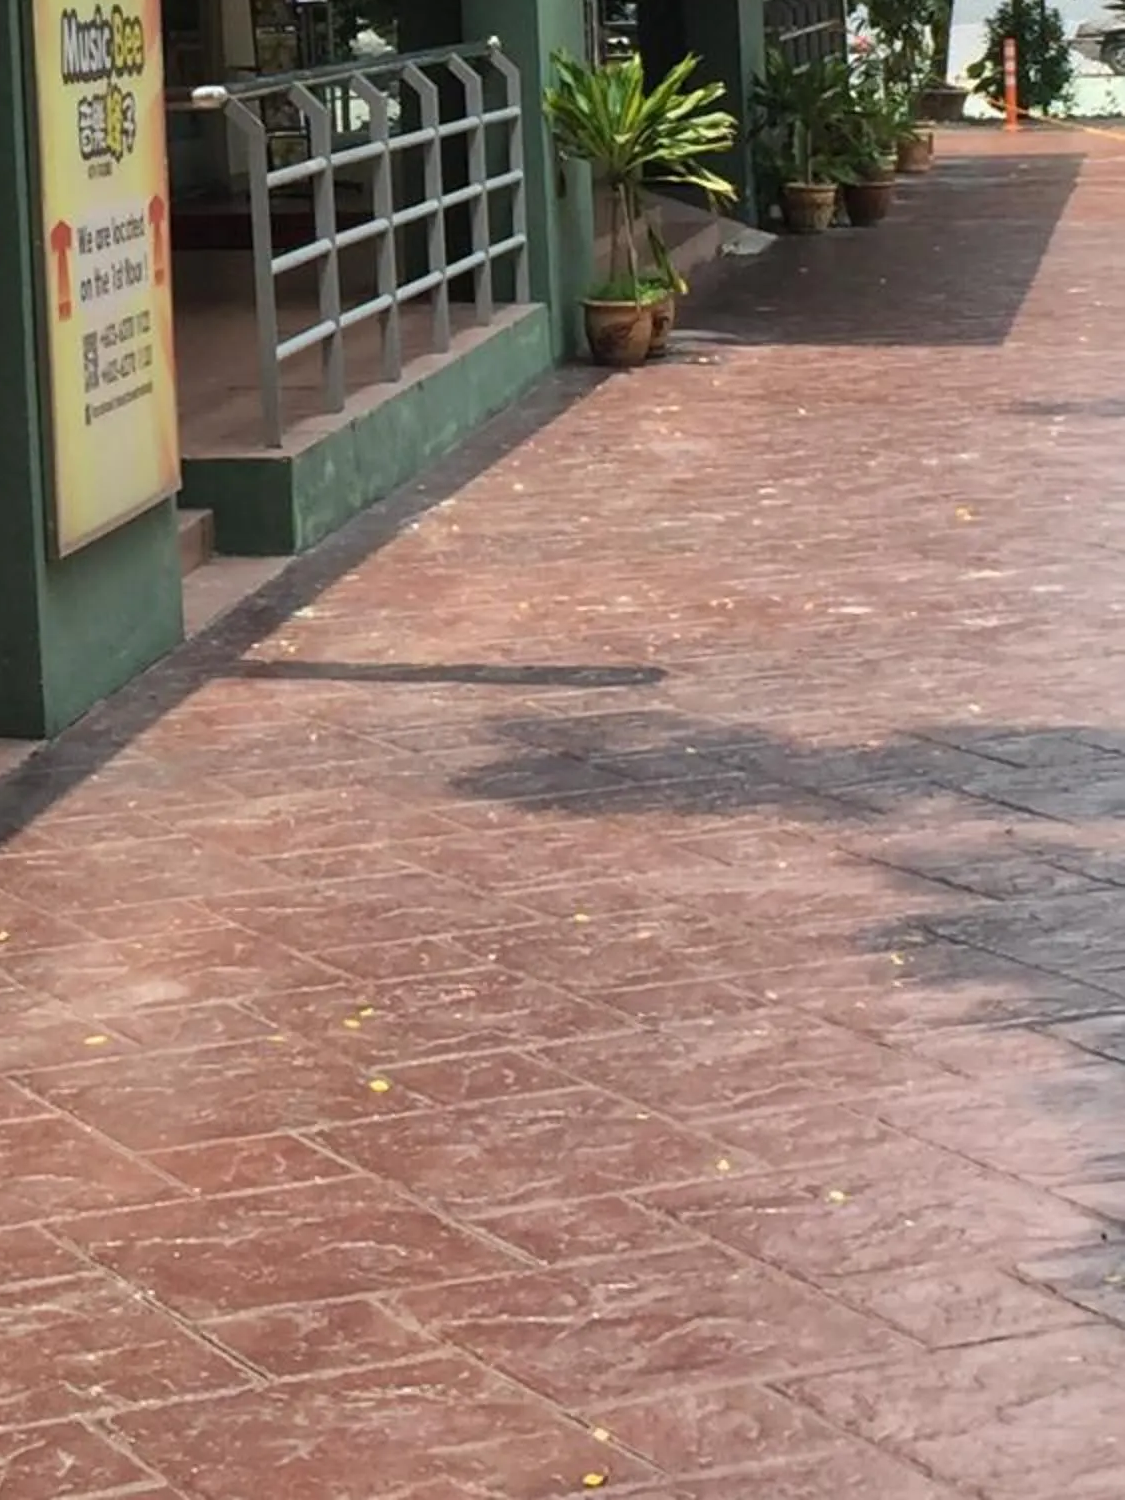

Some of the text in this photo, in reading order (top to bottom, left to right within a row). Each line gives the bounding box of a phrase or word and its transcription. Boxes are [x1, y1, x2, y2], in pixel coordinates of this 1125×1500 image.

[61, 4, 144, 84] Music Bee
[77, 211, 145, 255] We are located
[80, 277, 93, 302] on
[94, 266, 110, 298] the
